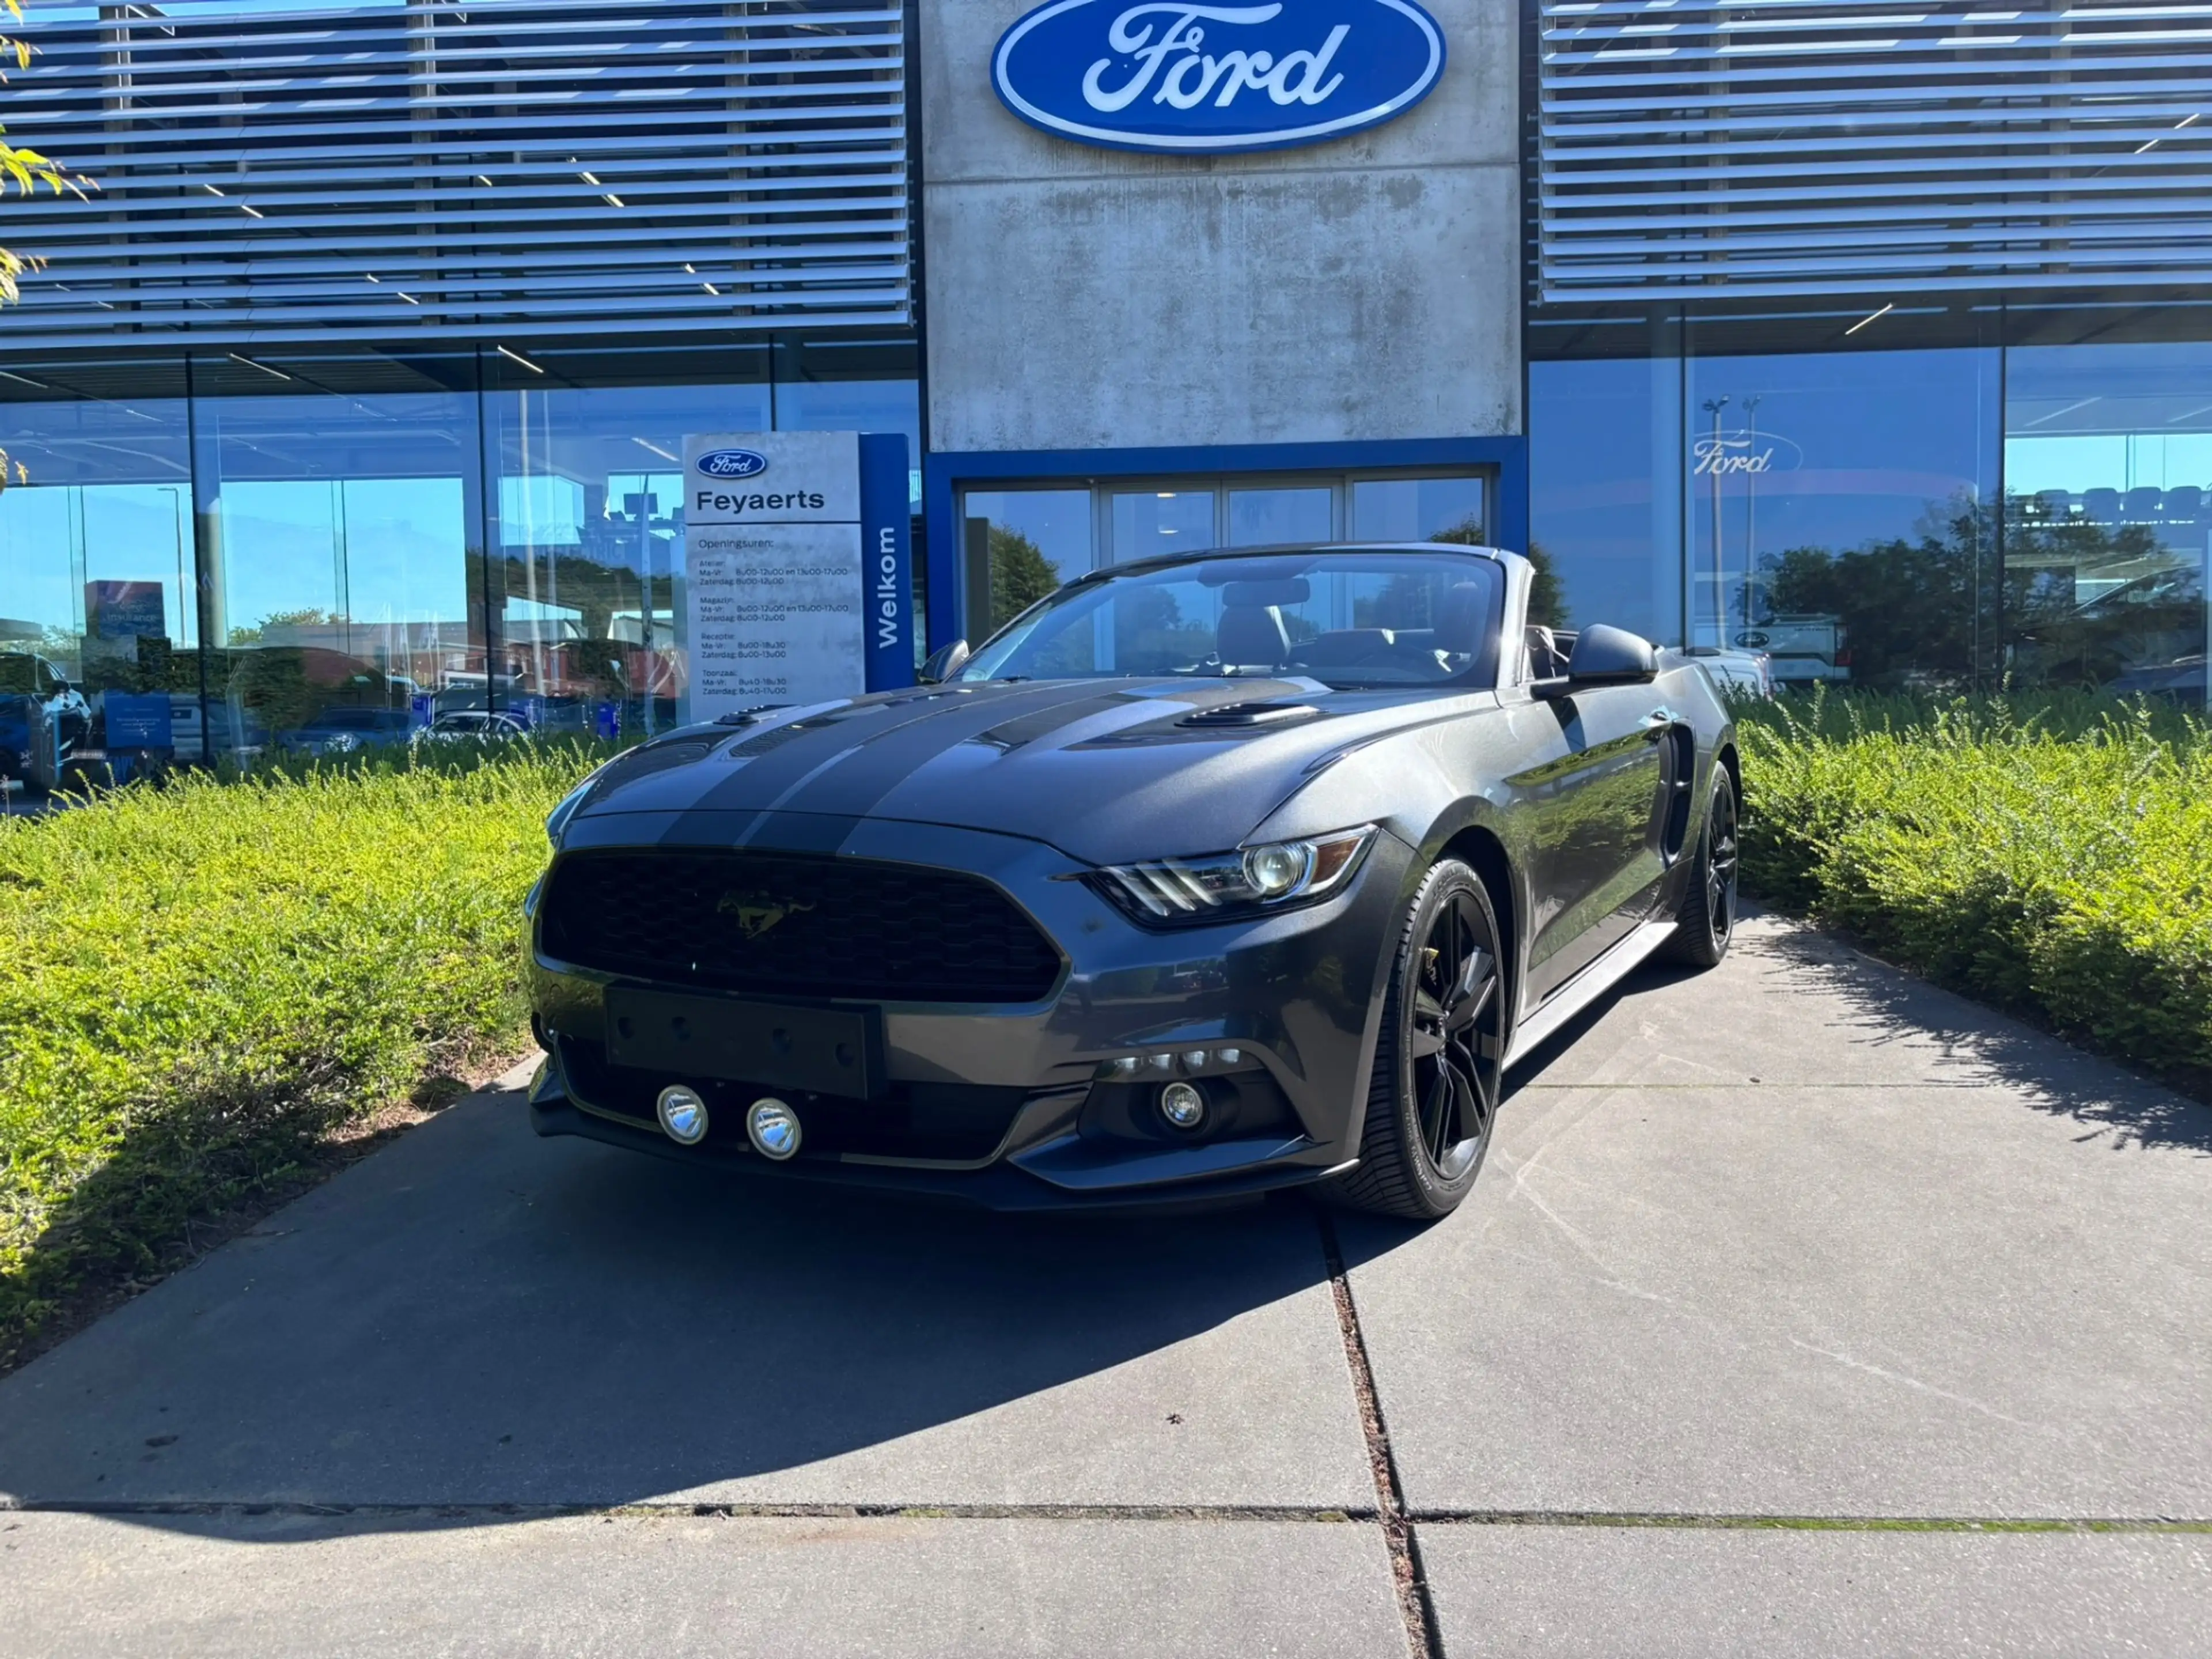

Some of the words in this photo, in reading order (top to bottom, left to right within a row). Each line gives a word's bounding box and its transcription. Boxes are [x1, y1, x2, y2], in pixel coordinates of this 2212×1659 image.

[1082, 2, 1351, 112] Ford
[710, 454, 752, 473] Ford
[1694, 440, 1774, 475] Ford
[697, 490, 825, 514] Feyaerts
[699, 539, 774, 549] Openingsuren:
[877, 527, 898, 649] Welkom
